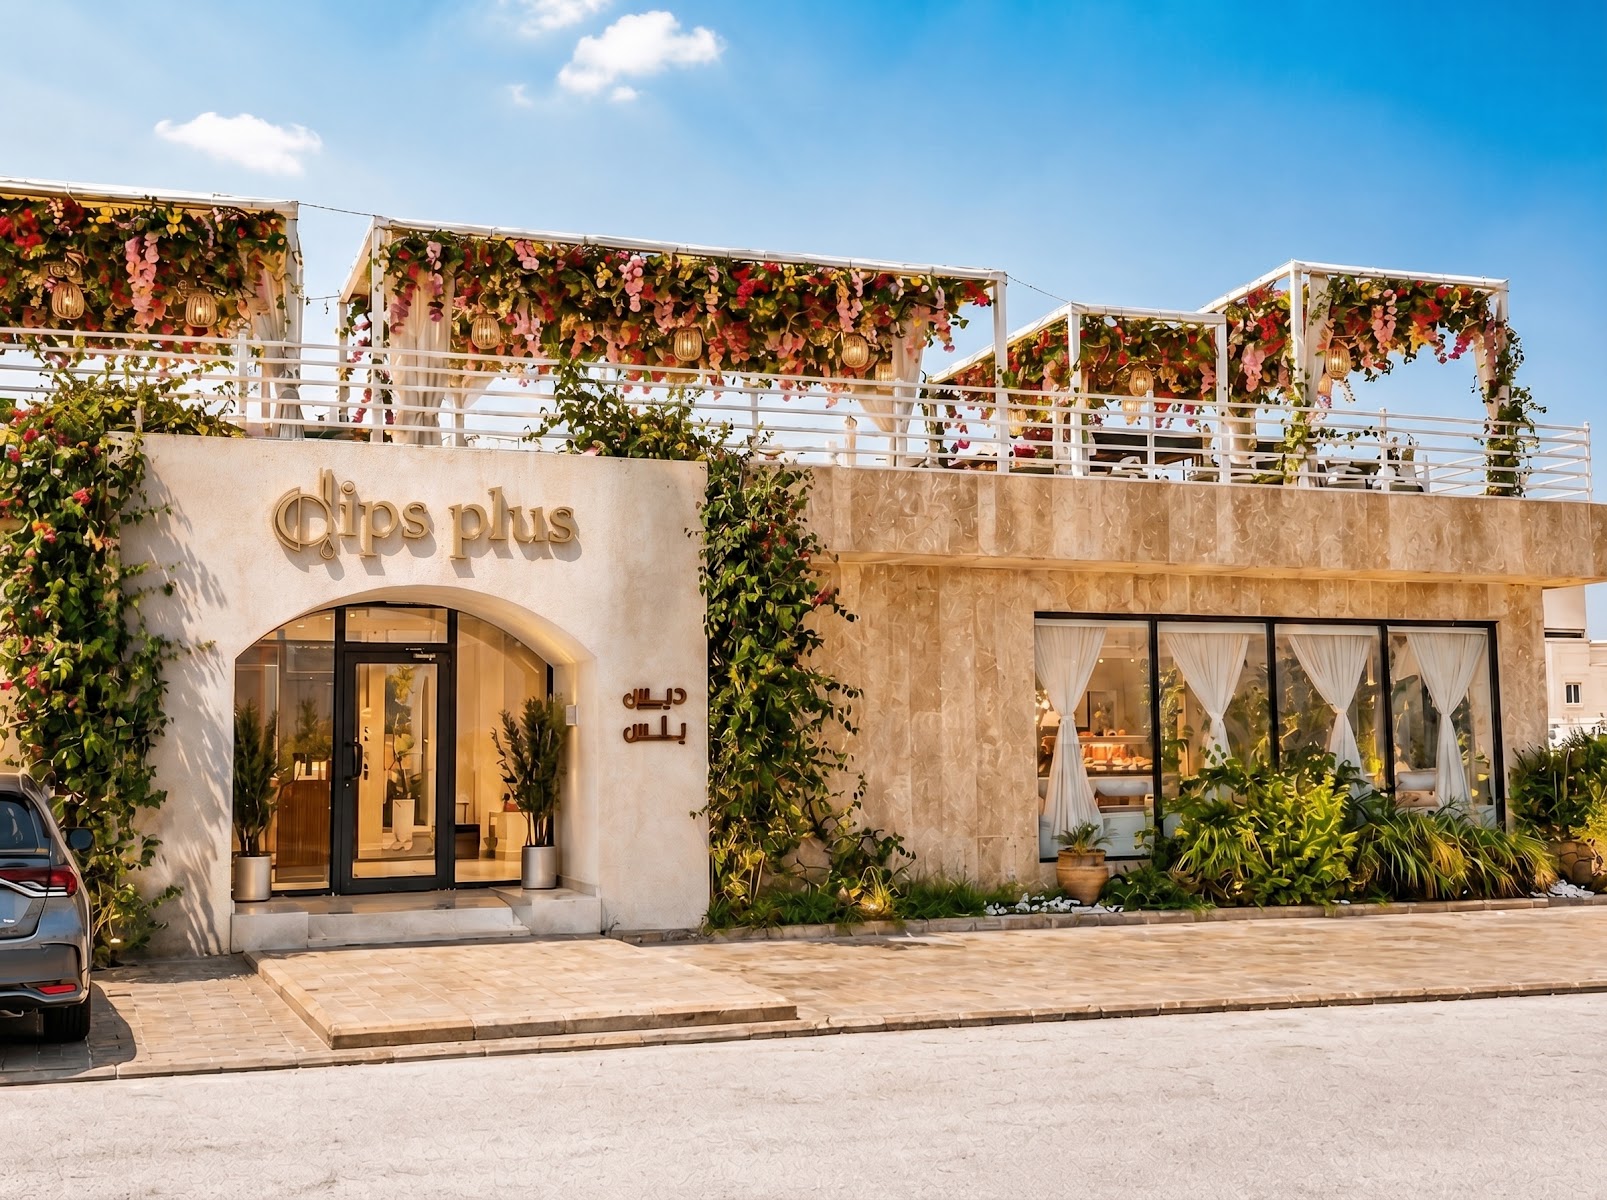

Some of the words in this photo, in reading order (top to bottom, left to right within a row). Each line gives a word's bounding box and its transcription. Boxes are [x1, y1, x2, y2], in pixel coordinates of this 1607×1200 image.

[272, 467, 428, 560] dips
[448, 486, 574, 559] plus
[622, 715, 687, 745] بلس
